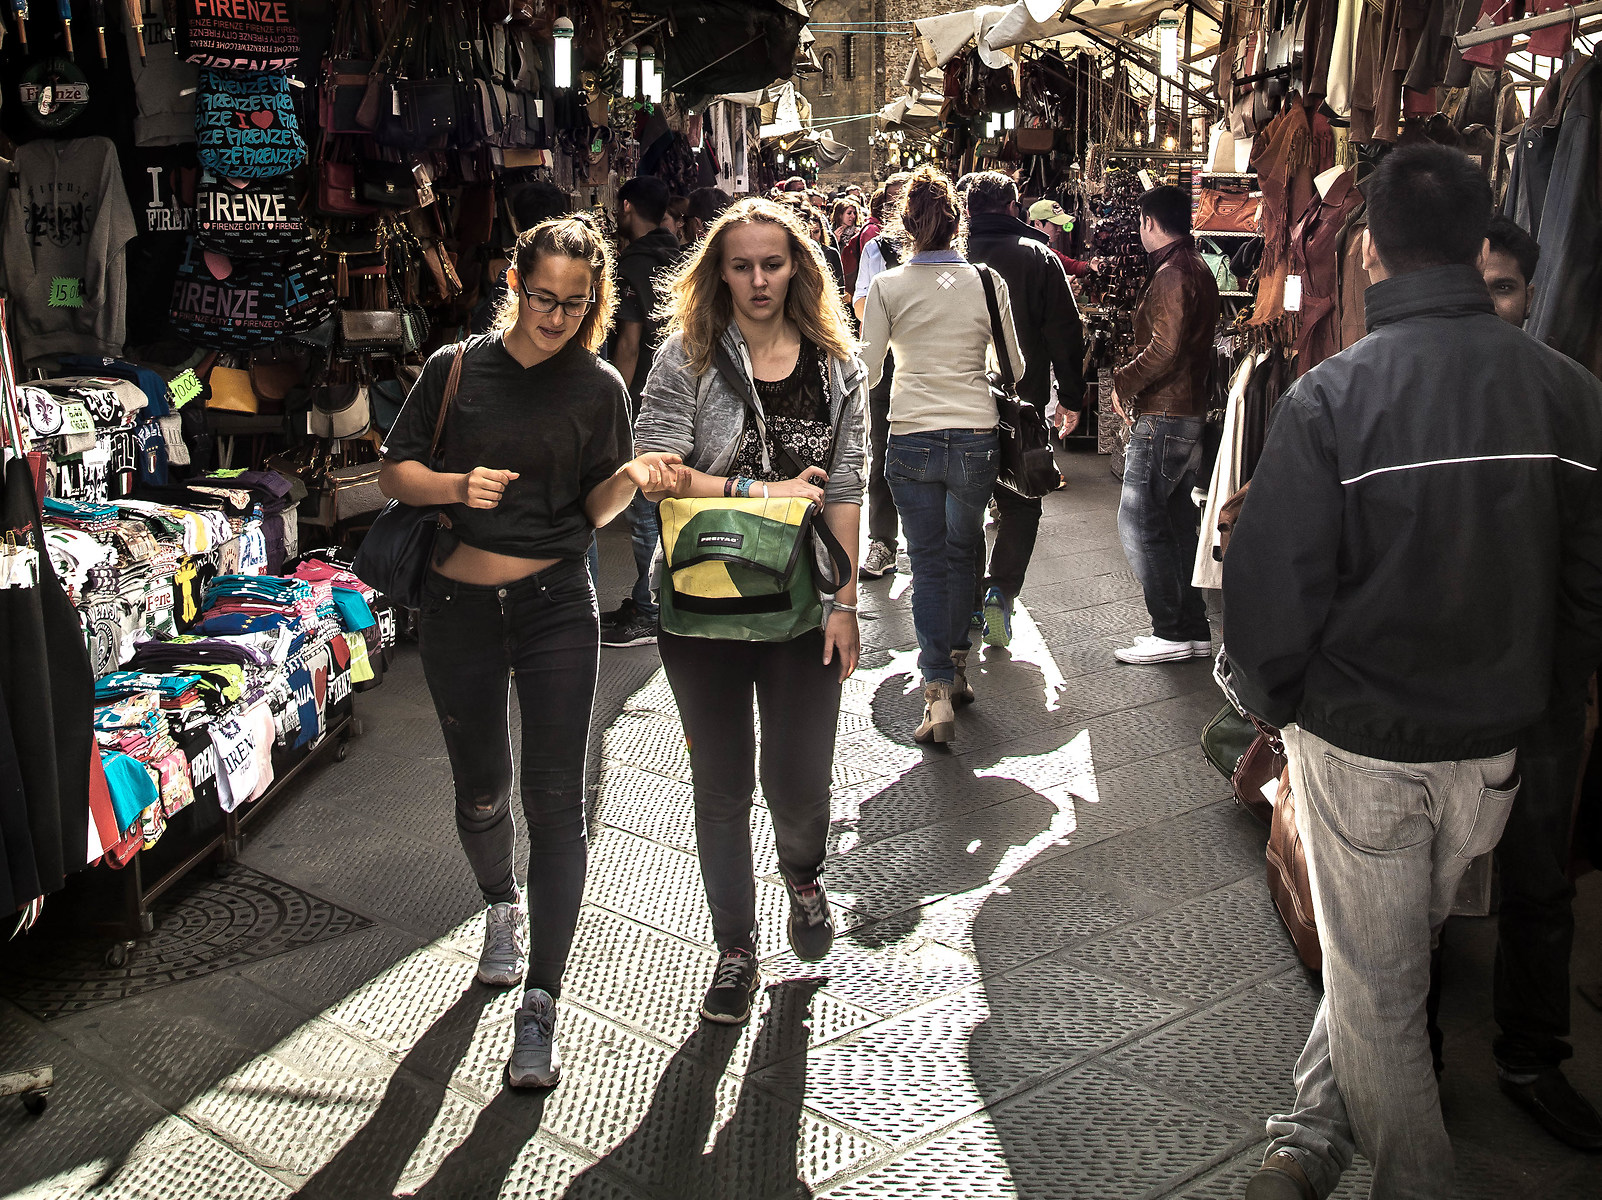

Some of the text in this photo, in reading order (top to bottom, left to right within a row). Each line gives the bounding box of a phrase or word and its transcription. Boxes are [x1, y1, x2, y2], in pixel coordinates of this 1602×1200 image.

[213, 20, 244, 31] FIRENZE
[245, 23, 274, 33] FIRENZE
[235, 111, 251, 129] I
[225, 127, 291, 146] FIRENZE
[146, 166, 164, 208] I
[196, 192, 288, 222] FIRENZE
[211, 221, 244, 232] FIRENZE
[244, 222, 261, 231] CITY
[170, 280, 260, 319] FIRENZE
[243, 317, 272, 328] FIRENZE
